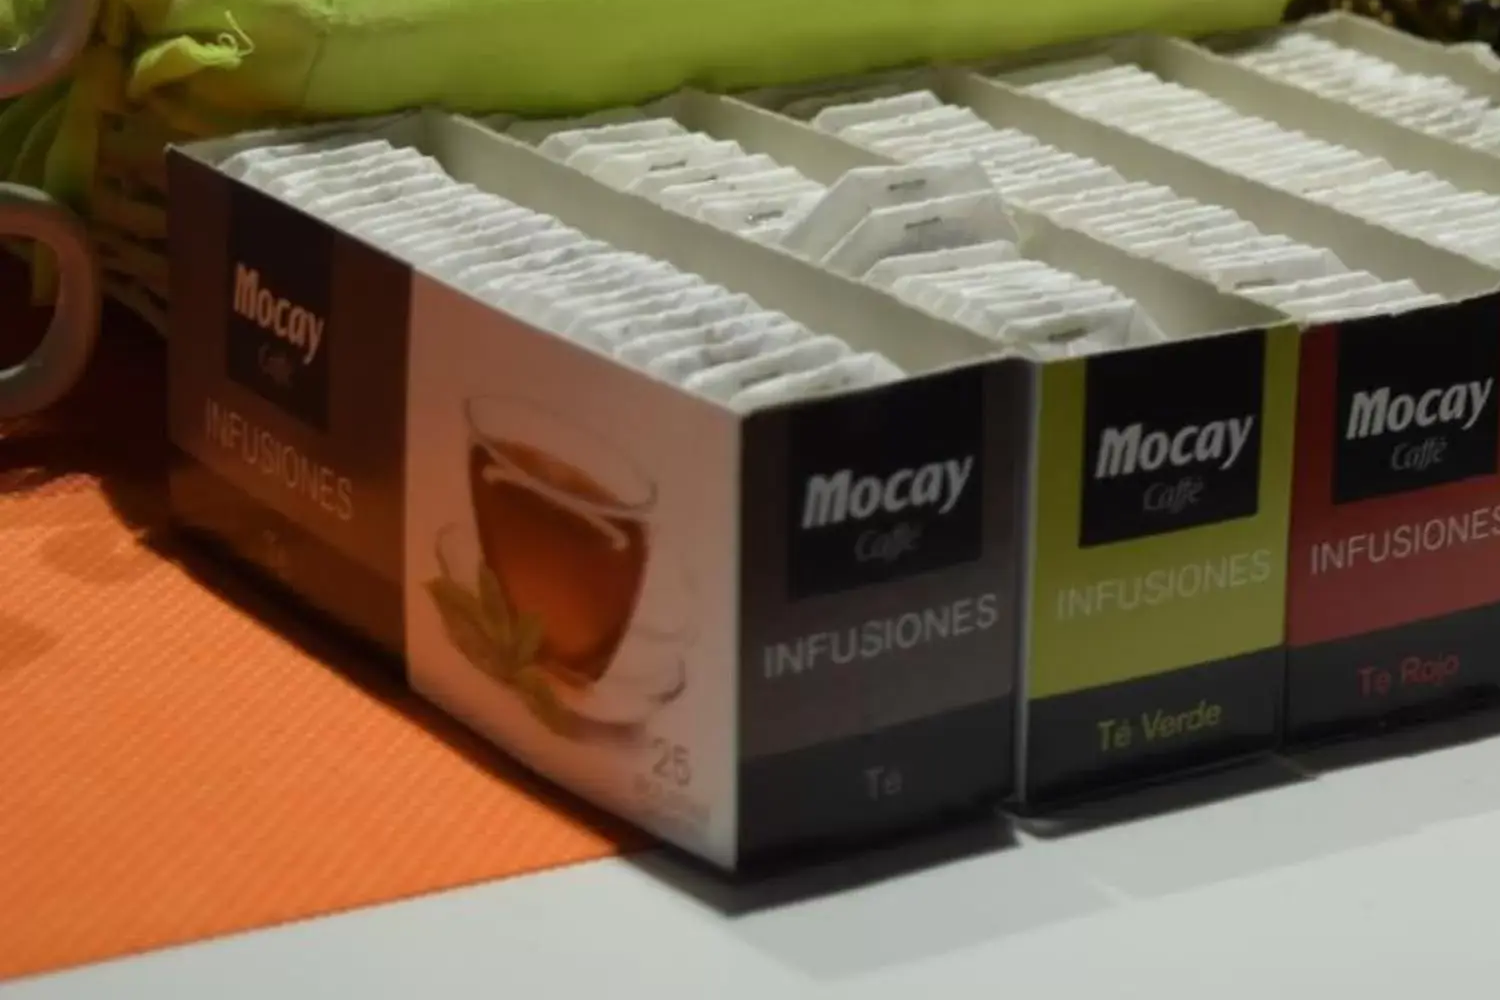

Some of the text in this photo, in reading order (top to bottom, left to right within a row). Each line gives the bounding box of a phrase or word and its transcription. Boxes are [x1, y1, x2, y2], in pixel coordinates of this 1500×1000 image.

[233, 263, 325, 366] Mocay
[1345, 376, 1495, 441] Mocay
[204, 397, 354, 523] INFUSIONES
[1094, 414, 1256, 480] Mocay
[800, 454, 975, 531] Mocay
[1056, 549, 1272, 622] INFUSIONES
[763, 593, 999, 680] INFUSIONES
[1140, 699, 1223, 742] Verde
